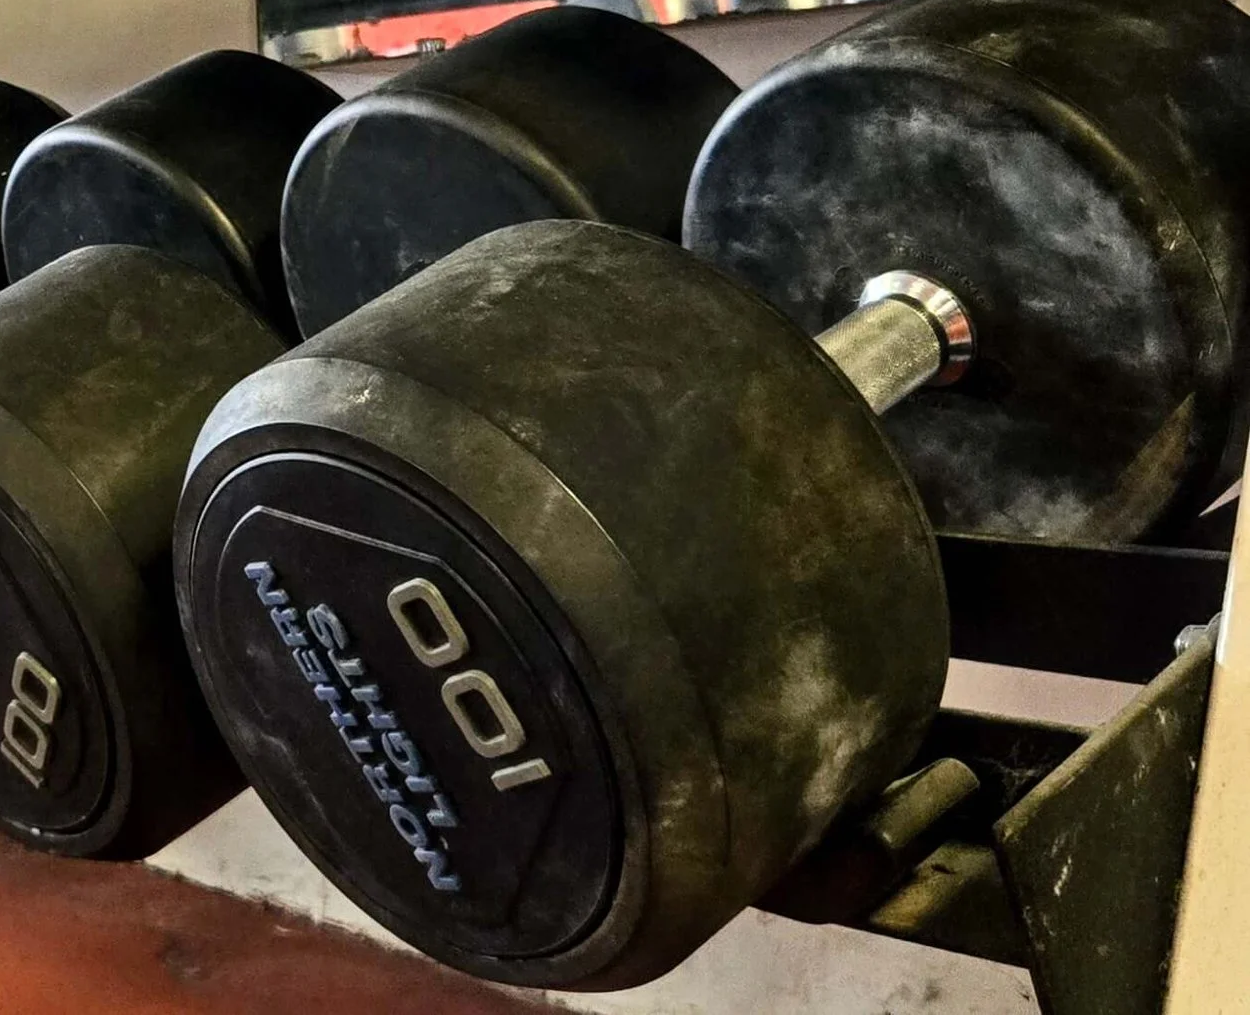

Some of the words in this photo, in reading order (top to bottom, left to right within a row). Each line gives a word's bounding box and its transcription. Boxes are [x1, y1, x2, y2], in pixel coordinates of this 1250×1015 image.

[0, 651, 59, 789] 100
[244, 561, 461, 891] NORTHERN
[306, 603, 458, 827] LIGHTS
[387, 577, 553, 792] 100
